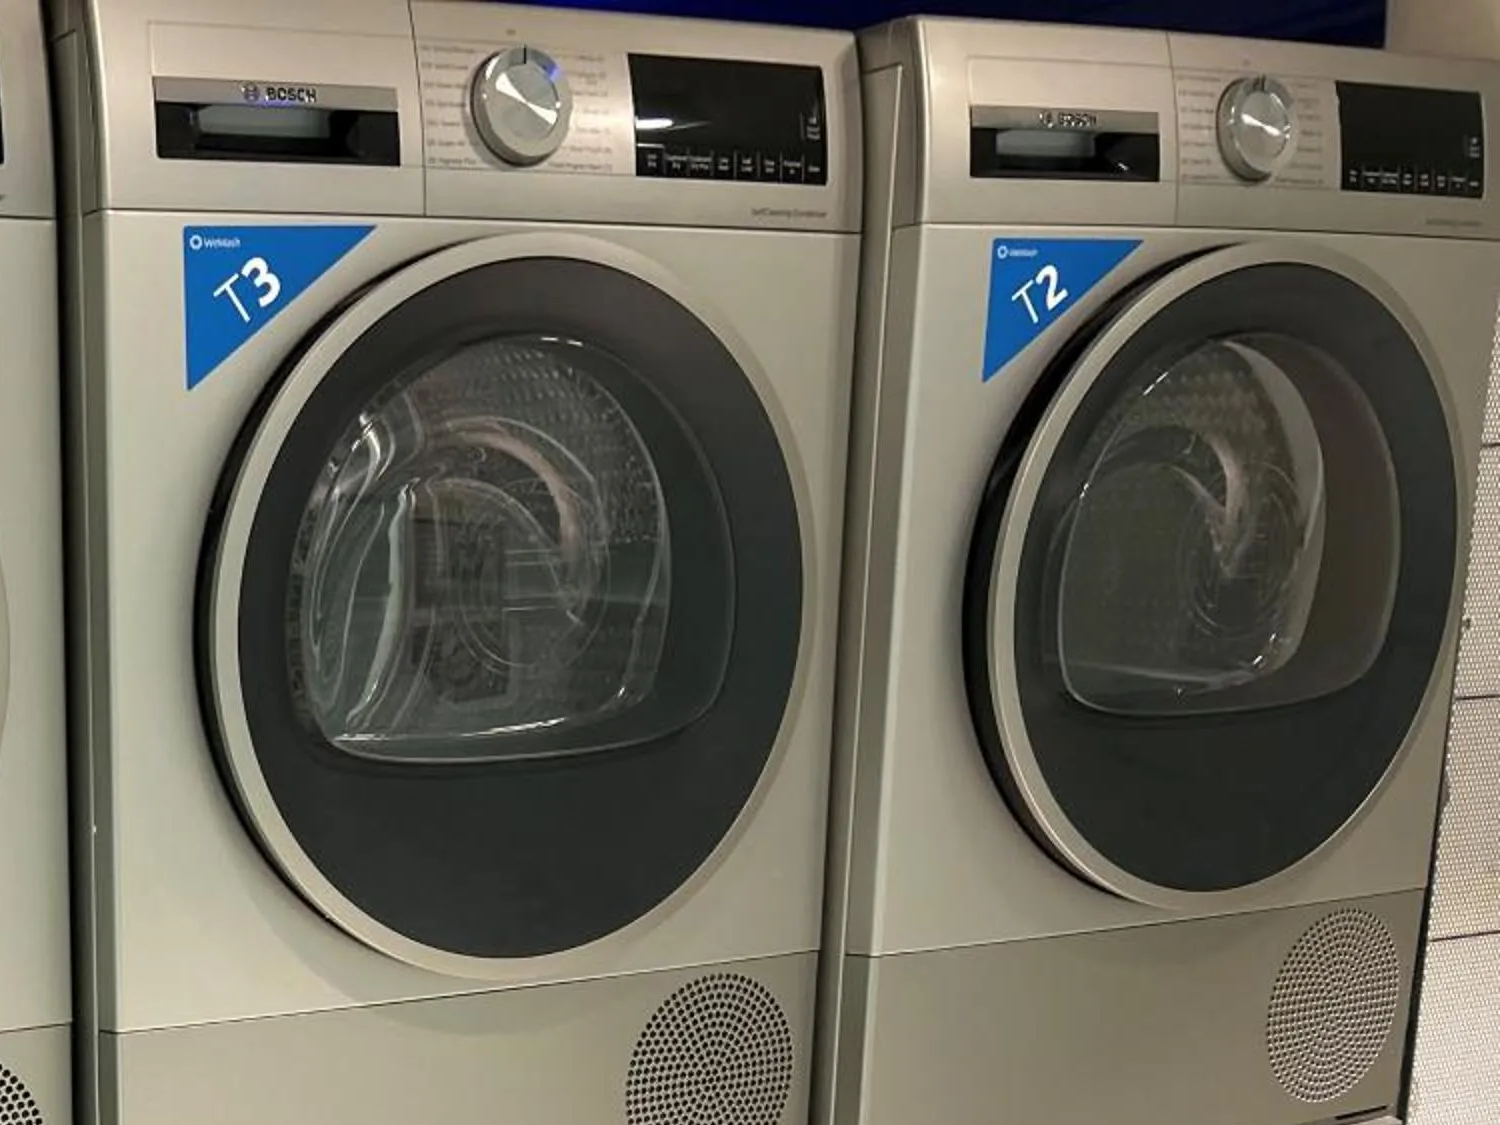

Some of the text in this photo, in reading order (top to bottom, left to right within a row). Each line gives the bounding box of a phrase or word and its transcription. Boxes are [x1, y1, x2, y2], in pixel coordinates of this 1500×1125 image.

[265, 86, 317, 103] BOSCH
[1057, 111, 1097, 127] BOSCH
[212, 256, 281, 323] T3
[1011, 264, 1069, 324] T2
